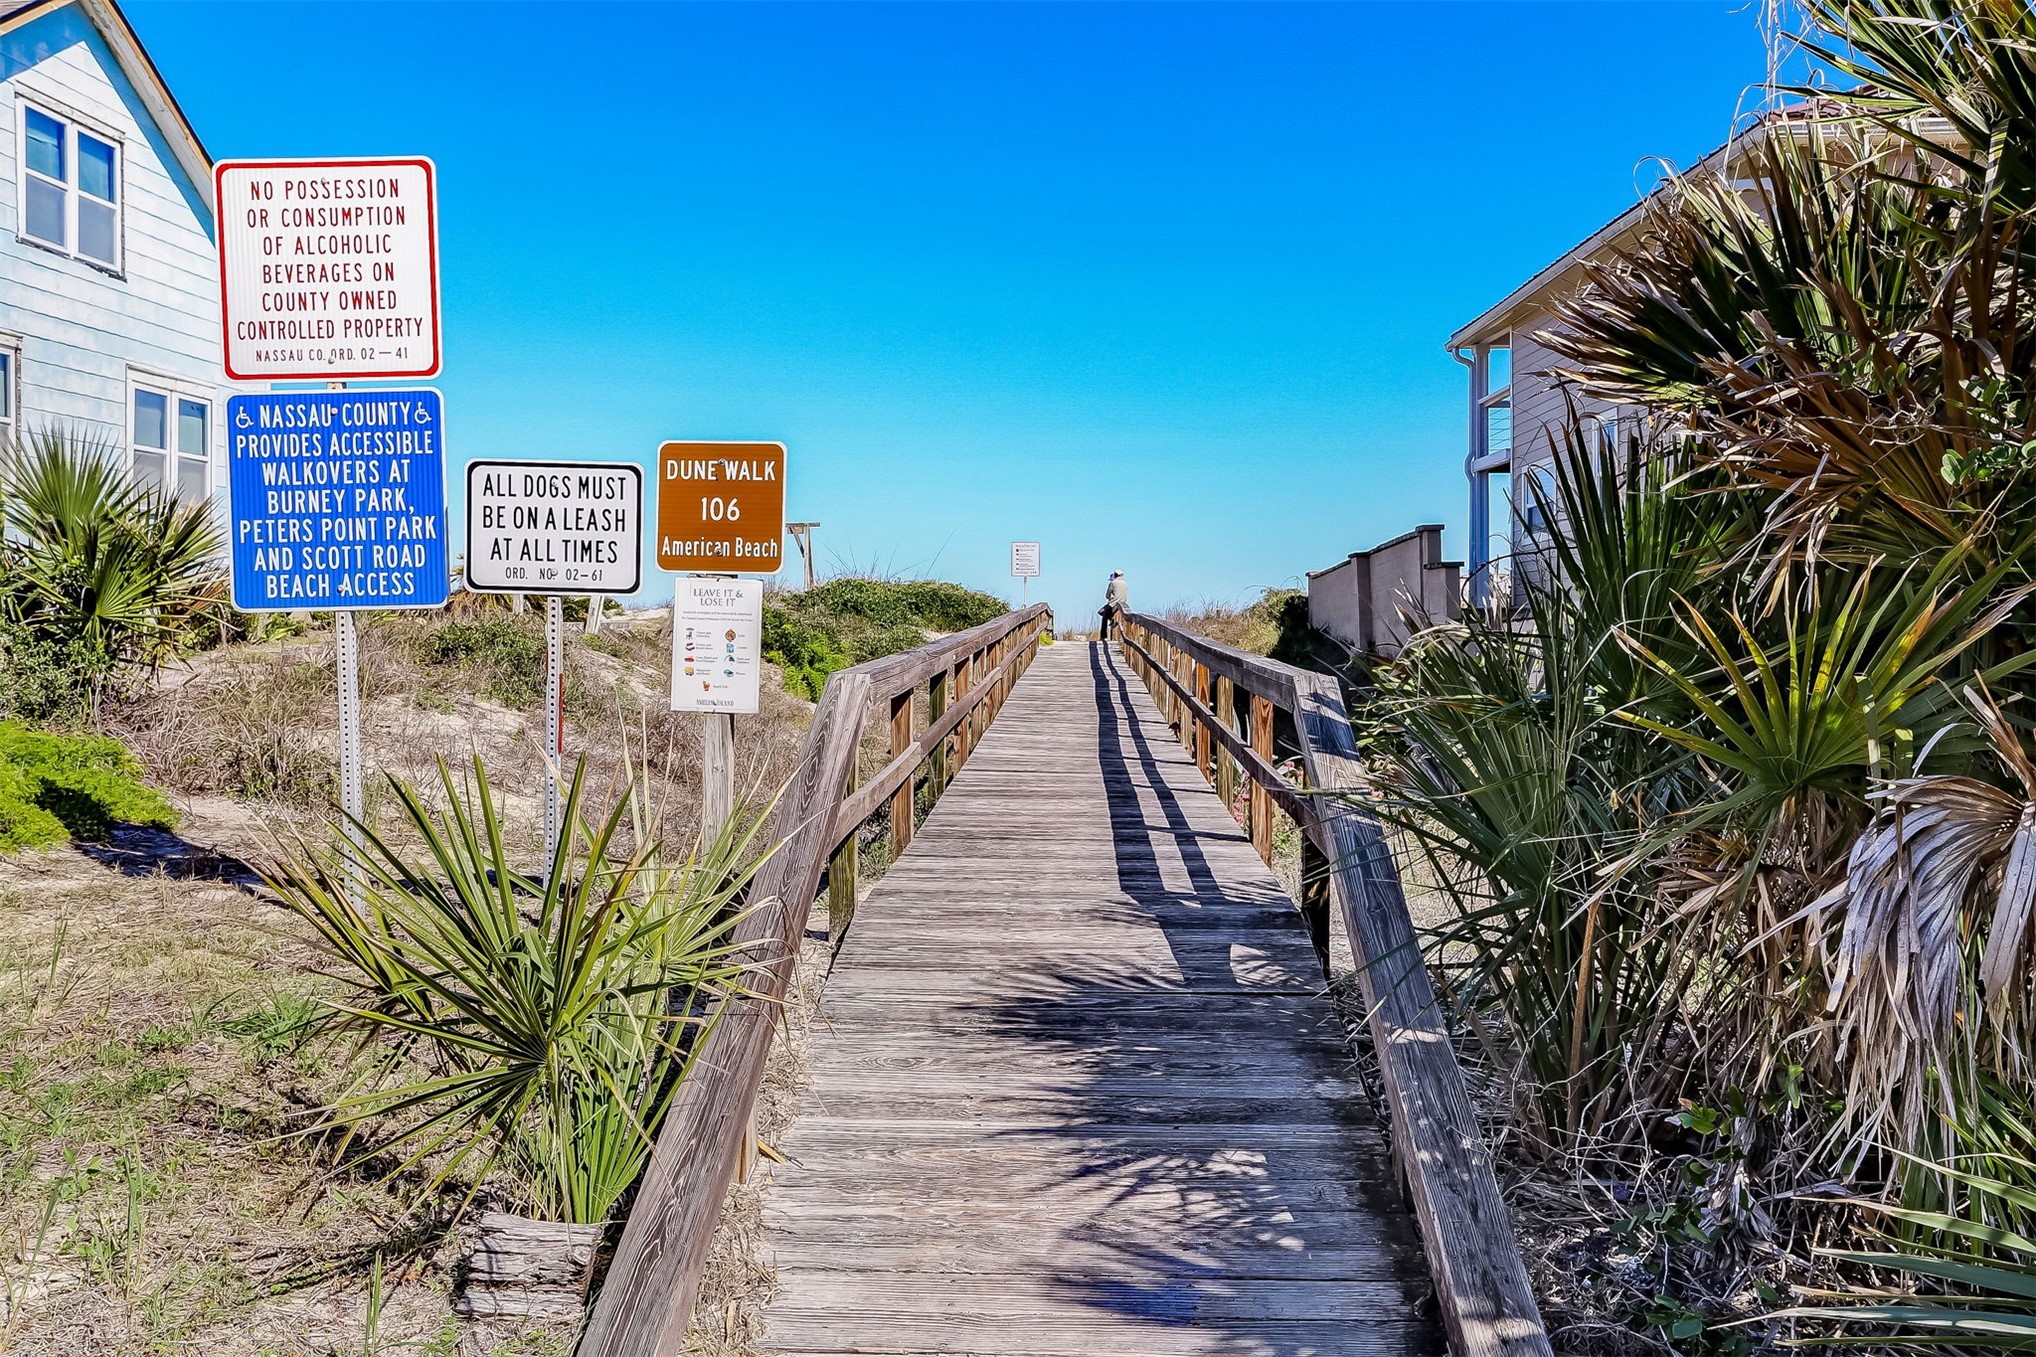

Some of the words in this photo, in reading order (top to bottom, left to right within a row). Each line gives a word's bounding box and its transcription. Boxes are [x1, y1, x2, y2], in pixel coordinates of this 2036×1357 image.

[250, 181, 273, 200] NO
[285, 178, 399, 200] POSSESSION
[247, 208, 269, 228] OR
[281, 206, 405, 227] CONSUMPTION
[263, 236, 283, 255] OF
[295, 234, 392, 255] ALCOHOLIC
[263, 263, 362, 284] BEVERAGES
[373, 262, 394, 281] ON
[262, 292, 329, 311] COUNTY
[339, 290, 397, 310] OWNED
[237, 319, 335, 340] CONTROLLED
[344, 318, 423, 338] PROPERTY
[256, 349, 303, 362] NASSAU
[309, 349, 326, 361] CO.
[259, 403, 332, 428] NASSAU
[342, 402, 411, 427] COUNTY
[236, 433, 322, 458] PROVIDES
[329, 430, 433, 456] ACCESSIBLE
[262, 460, 379, 486] WALKOVERS
[389, 459, 410, 483] AT
[666, 459, 718, 480] DUNE
[724, 460, 775, 481] WALK
[483, 473, 516, 497] ALL
[524, 474, 571, 498] DOGS
[578, 476, 626, 500] MUST
[267, 489, 345, 514] BURNEY
[356, 488, 414, 515] PARK,
[701, 496, 740, 521] 106
[239, 518, 313, 543] PETERS
[322, 517, 377, 542] POINT
[385, 516, 436, 540] PARK
[483, 505, 506, 529] BE
[513, 506, 538, 529] ON
[544, 507, 557, 530] A
[563, 507, 625, 532] LEASH
[254, 548, 293, 571] AND
[302, 546, 363, 570] SCOTT
[373, 545, 425, 569] ROAD
[490, 537, 512, 561] AT
[520, 538, 555, 562] ALL
[562, 539, 618, 564] TIMES
[661, 535, 730, 557] American
[735, 537, 777, 558] Beach
[505, 566, 528, 580] ORD.
[267, 574, 329, 599] BEACH
[340, 572, 414, 597] ACCESS
[693, 588, 721, 597] LEAVE
[724, 589, 734, 597] IT
[735, 589, 743, 598] &
[700, 597, 723, 606] LOSE
[726, 598, 736, 607] IT
